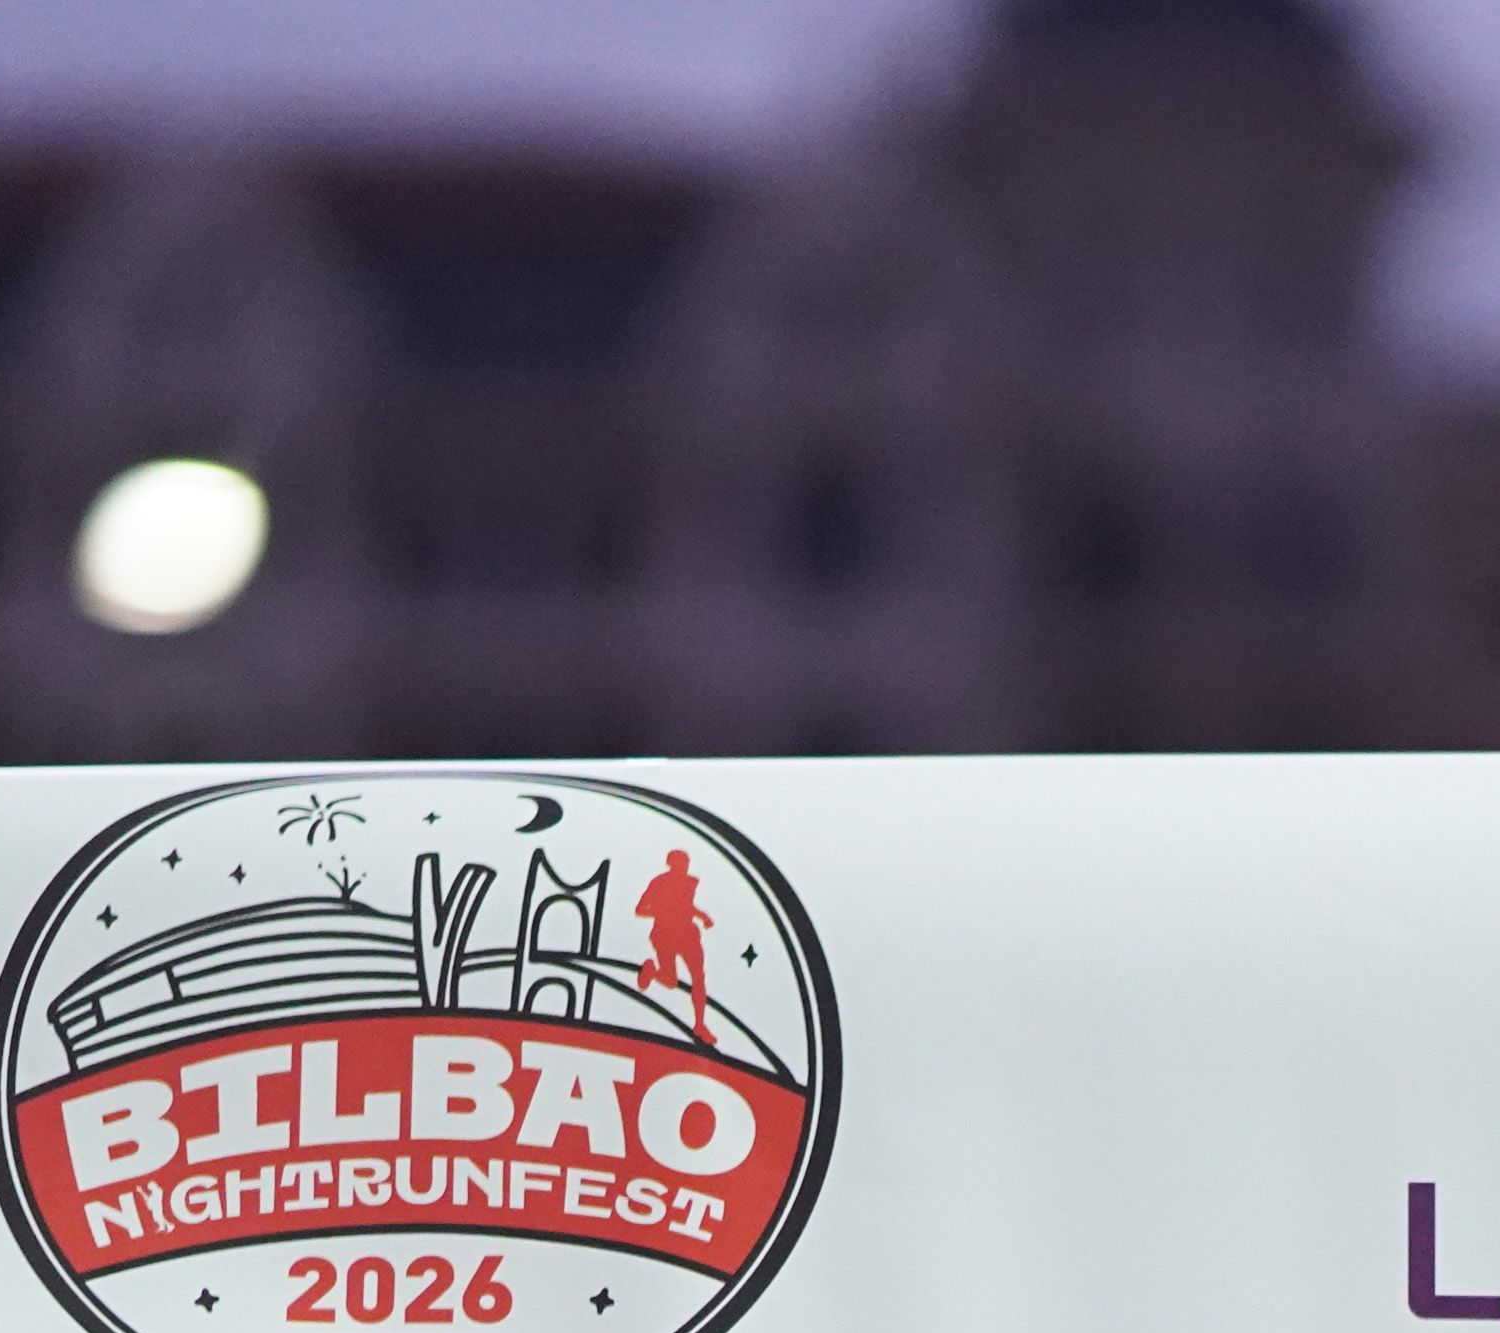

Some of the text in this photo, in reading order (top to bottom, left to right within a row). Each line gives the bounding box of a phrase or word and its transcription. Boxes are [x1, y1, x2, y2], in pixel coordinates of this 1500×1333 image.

[61, 1035, 757, 1191] BILBAO
[84, 1156, 727, 1248] NIGHTRUNFEST
[286, 1255, 514, 1325] 2026
